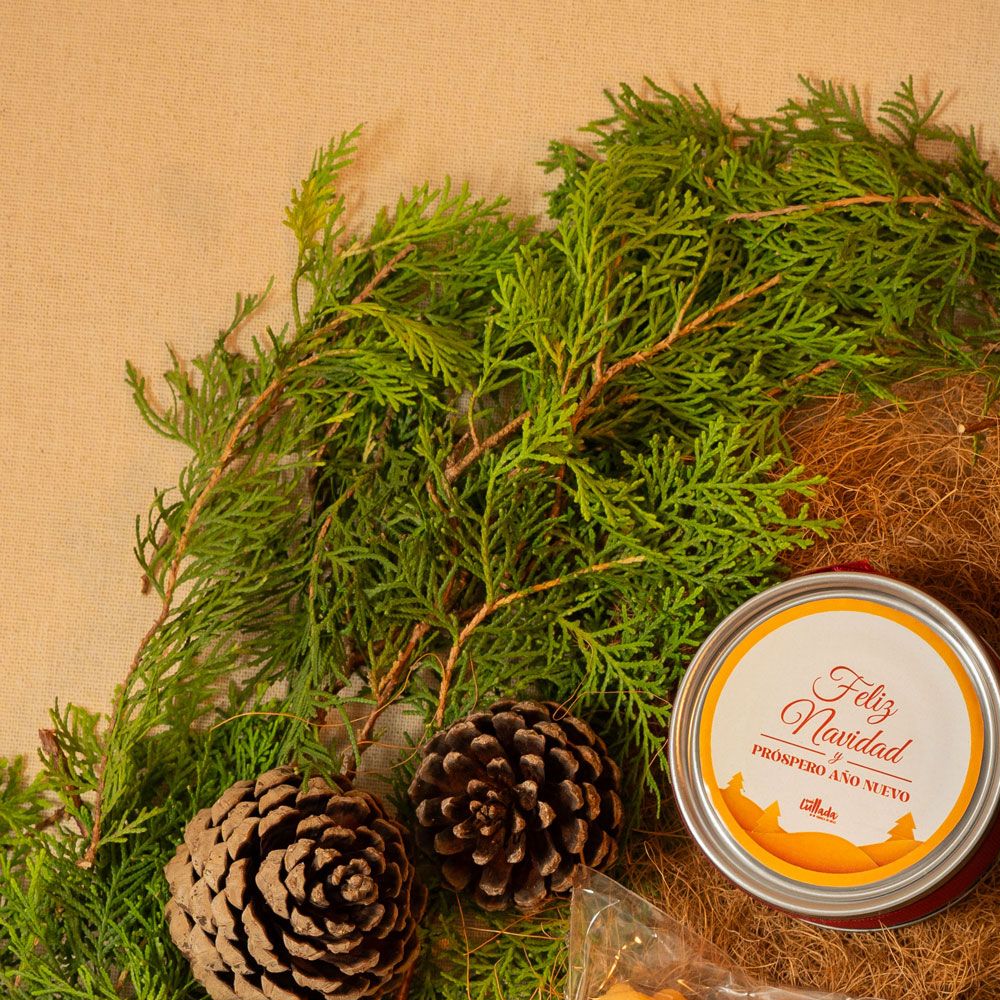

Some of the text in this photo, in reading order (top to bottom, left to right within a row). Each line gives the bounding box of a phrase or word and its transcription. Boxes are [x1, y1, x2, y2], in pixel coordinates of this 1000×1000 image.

[812, 665, 899, 724] Feliz
[780, 699, 913, 764] Navidad
[827, 751, 844, 765] y
[751, 743, 911, 803] PRÓSPERO AÑO NUEVO
